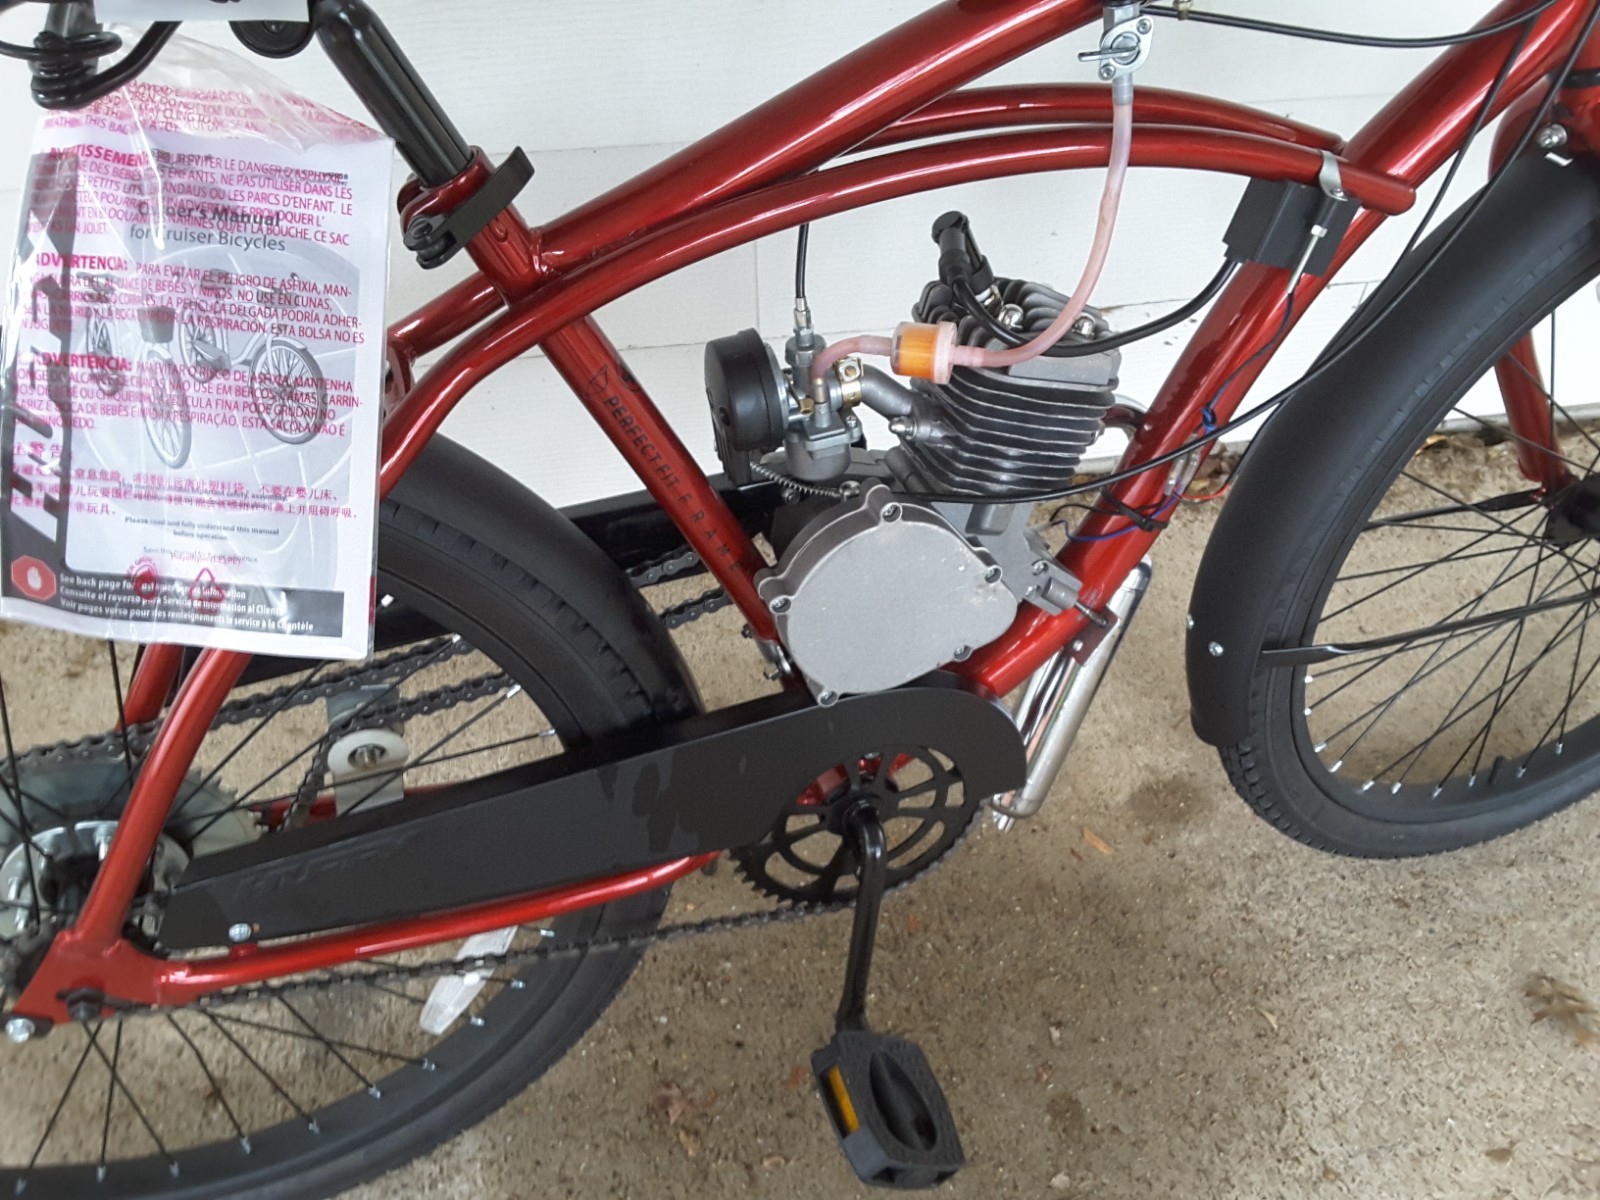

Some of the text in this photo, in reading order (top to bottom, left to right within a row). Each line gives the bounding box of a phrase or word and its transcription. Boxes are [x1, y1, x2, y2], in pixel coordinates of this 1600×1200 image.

[221, 173, 234, 186] NE
[303, 182, 333, 198] DANS
[335, 186, 353, 200] LES
[160, 181, 208, 198] ANDAUS
[248, 191, 280, 206] PARCS
[341, 203, 353, 216] LE
[211, 207, 281, 228] Manual
[130, 223, 150, 239] for
[218, 231, 286, 251] Bicycles
[314, 230, 327, 242] CE
[329, 232, 350, 246] SAC
[218, 271, 261, 288] PELIGRO
[264, 276, 277, 289] DE
[237, 290, 254, 302] NO
[256, 291, 276, 306] USE
[278, 295, 293, 307] EN
[229, 303, 278, 319] DELGADA
[299, 327, 331, 341] BOLSA
[334, 330, 350, 343] NO
[352, 332, 365, 344] ES
[233, 370, 247, 383] DE
[216, 383, 232, 396] EM
[216, 398, 239, 412] FINA
[606, 397, 662, 464] PERFECT
[76, 576, 97, 588] back
[99, 579, 121, 592] page
[60, 586, 97, 600] Consulte
[108, 592, 142, 605] reverso
[256, 604, 287, 616] Client
[78, 602, 104, 615] pages
[130, 607, 152, 619] pour
